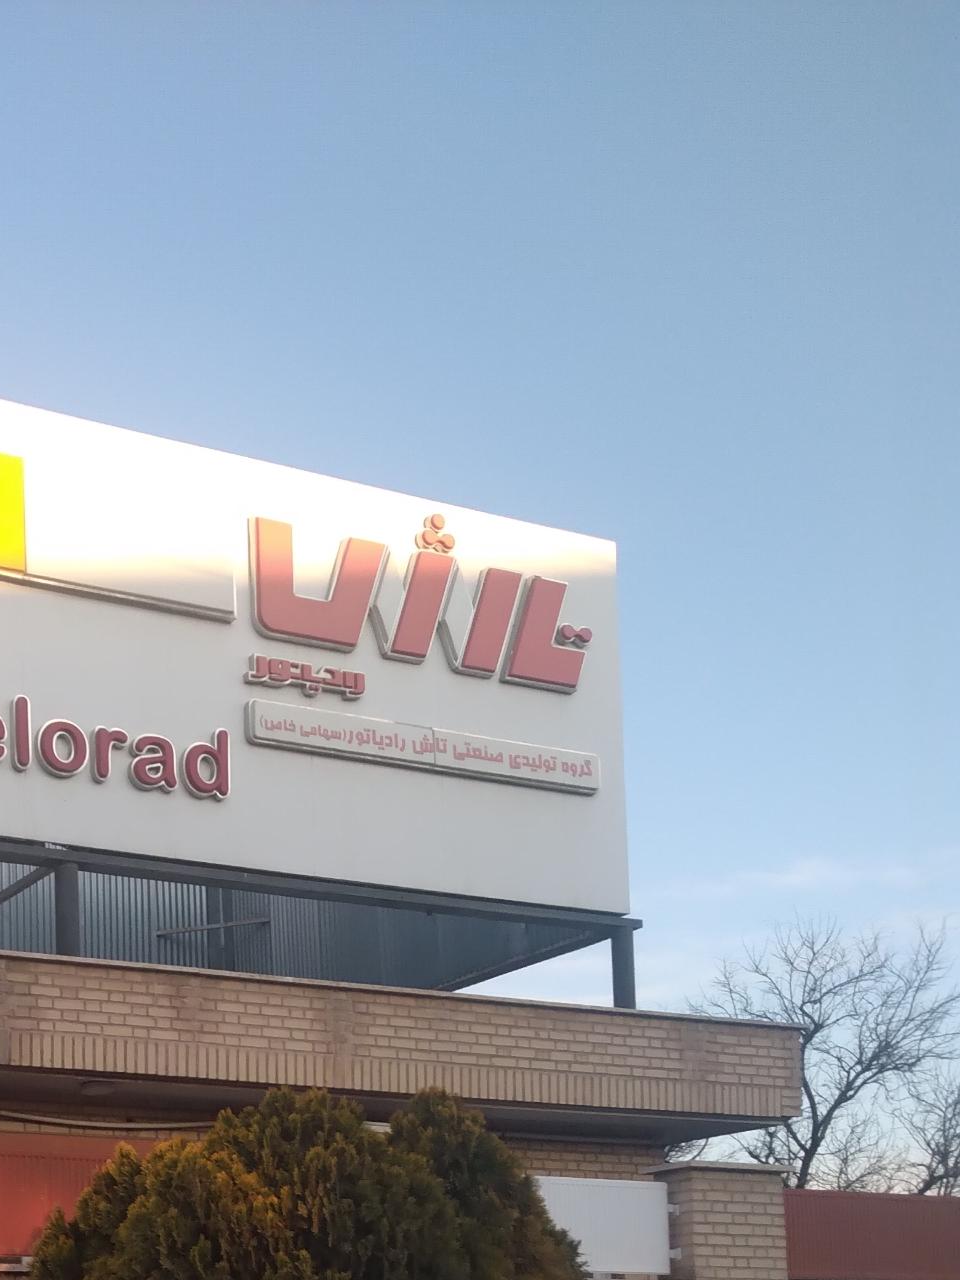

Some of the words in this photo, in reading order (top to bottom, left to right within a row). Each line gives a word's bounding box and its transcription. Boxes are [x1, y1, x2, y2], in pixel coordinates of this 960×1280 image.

[411, 733, 448, 755] تاش
[452, 742, 504, 763] صنعتی
[508, 753, 557, 773] تولیدی
[560, 758, 593, 778] گروه
